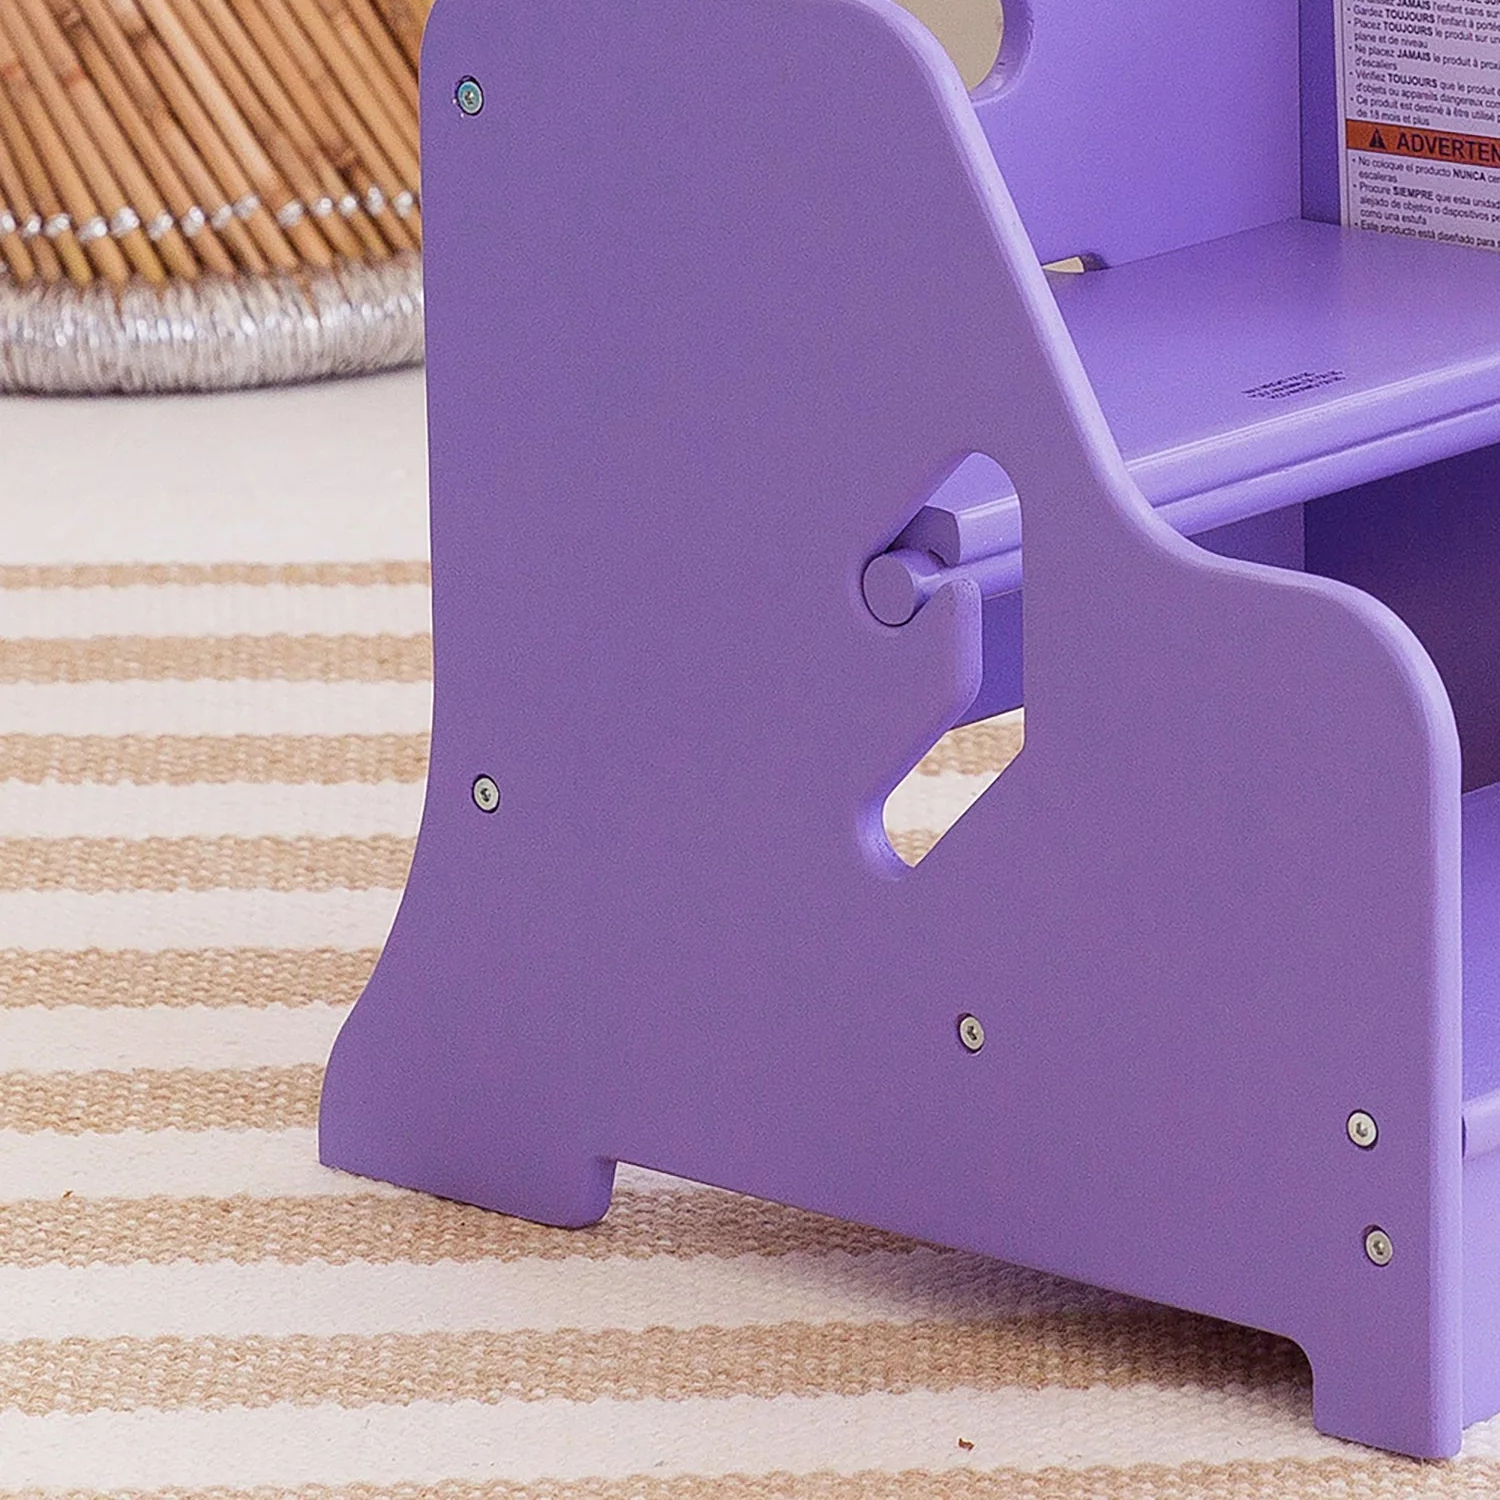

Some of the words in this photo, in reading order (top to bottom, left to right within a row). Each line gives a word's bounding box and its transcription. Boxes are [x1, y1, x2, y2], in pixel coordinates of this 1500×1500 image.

[1353, 4, 1383, 18] Gardez
[1385, 8, 1435, 23] TOUJOURS
[1468, 19, 1474, 28] à
[1464, 7, 1483, 17] sans
[1353, 17, 1381, 30] Placez
[1383, 21, 1433, 36] TOUJOURS
[1434, 27, 1442, 38] le
[1444, 30, 1473, 41] produit
[1474, 34, 1488, 43] sur
[1354, 31, 1376, 42] plane
[1378, 35, 1386, 43] et
[1388, 35, 1399, 45] de
[1401, 38, 1428, 49] niveau
[1354, 43, 1366, 54] Ne
[1368, 46, 1394, 57] placez
[1397, 49, 1431, 61] JAMAIS
[1433, 53, 1441, 63] le
[1442, 56, 1471, 67] produit
[1472, 58, 1478, 68] à
[1355, 69, 1385, 82] Vérifiez
[1388, 73, 1437, 88] TOUJOURS
[1439, 81, 1455, 91] que
[1457, 82, 1465, 92] le
[1467, 85, 1495, 95] produit
[1356, 94, 1368, 105] Ce
[1370, 98, 1398, 109] produit
[1399, 102, 1412, 111] est
[1414, 103, 1444, 115] destiné
[1445, 106, 1451, 116] à
[1388, 87, 1399, 96] ou
[1401, 89, 1438, 101] appareils
[1440, 93, 1483, 107] dangereux
[1356, 108, 1367, 118] de
[1369, 109, 1379, 119] 18
[1381, 112, 1401, 122] mois
[1402, 114, 1411, 123] et
[1412, 115, 1430, 126] plus
[1358, 156, 1370, 166] No
[1372, 160, 1404, 171] coloque
[1405, 163, 1413, 172] el
[1415, 165, 1451, 177] producto
[1453, 168, 1486, 181] NUNCA
[1358, 171, 1397, 183] escaleras
[1359, 181, 1390, 195] Procure
[1393, 186, 1433, 200] SIEMPRE
[1435, 193, 1451, 203] que
[1453, 196, 1471, 205] esta
[1472, 199, 1500, 209] unidad
[1360, 196, 1389, 207] alejado
[1390, 199, 1401, 209] de
[1403, 201, 1432, 213] objetos
[1434, 206, 1440, 214] o
[1360, 209, 1382, 219] como
[1384, 213, 1399, 221] una
[1401, 215, 1427, 225] estufa
[1360, 219, 1379, 232] Este
[1380, 224, 1416, 236] producto
[1417, 230, 1435, 239] está
[1437, 231, 1474, 245] diseñado
[1476, 237, 1495, 247] para
